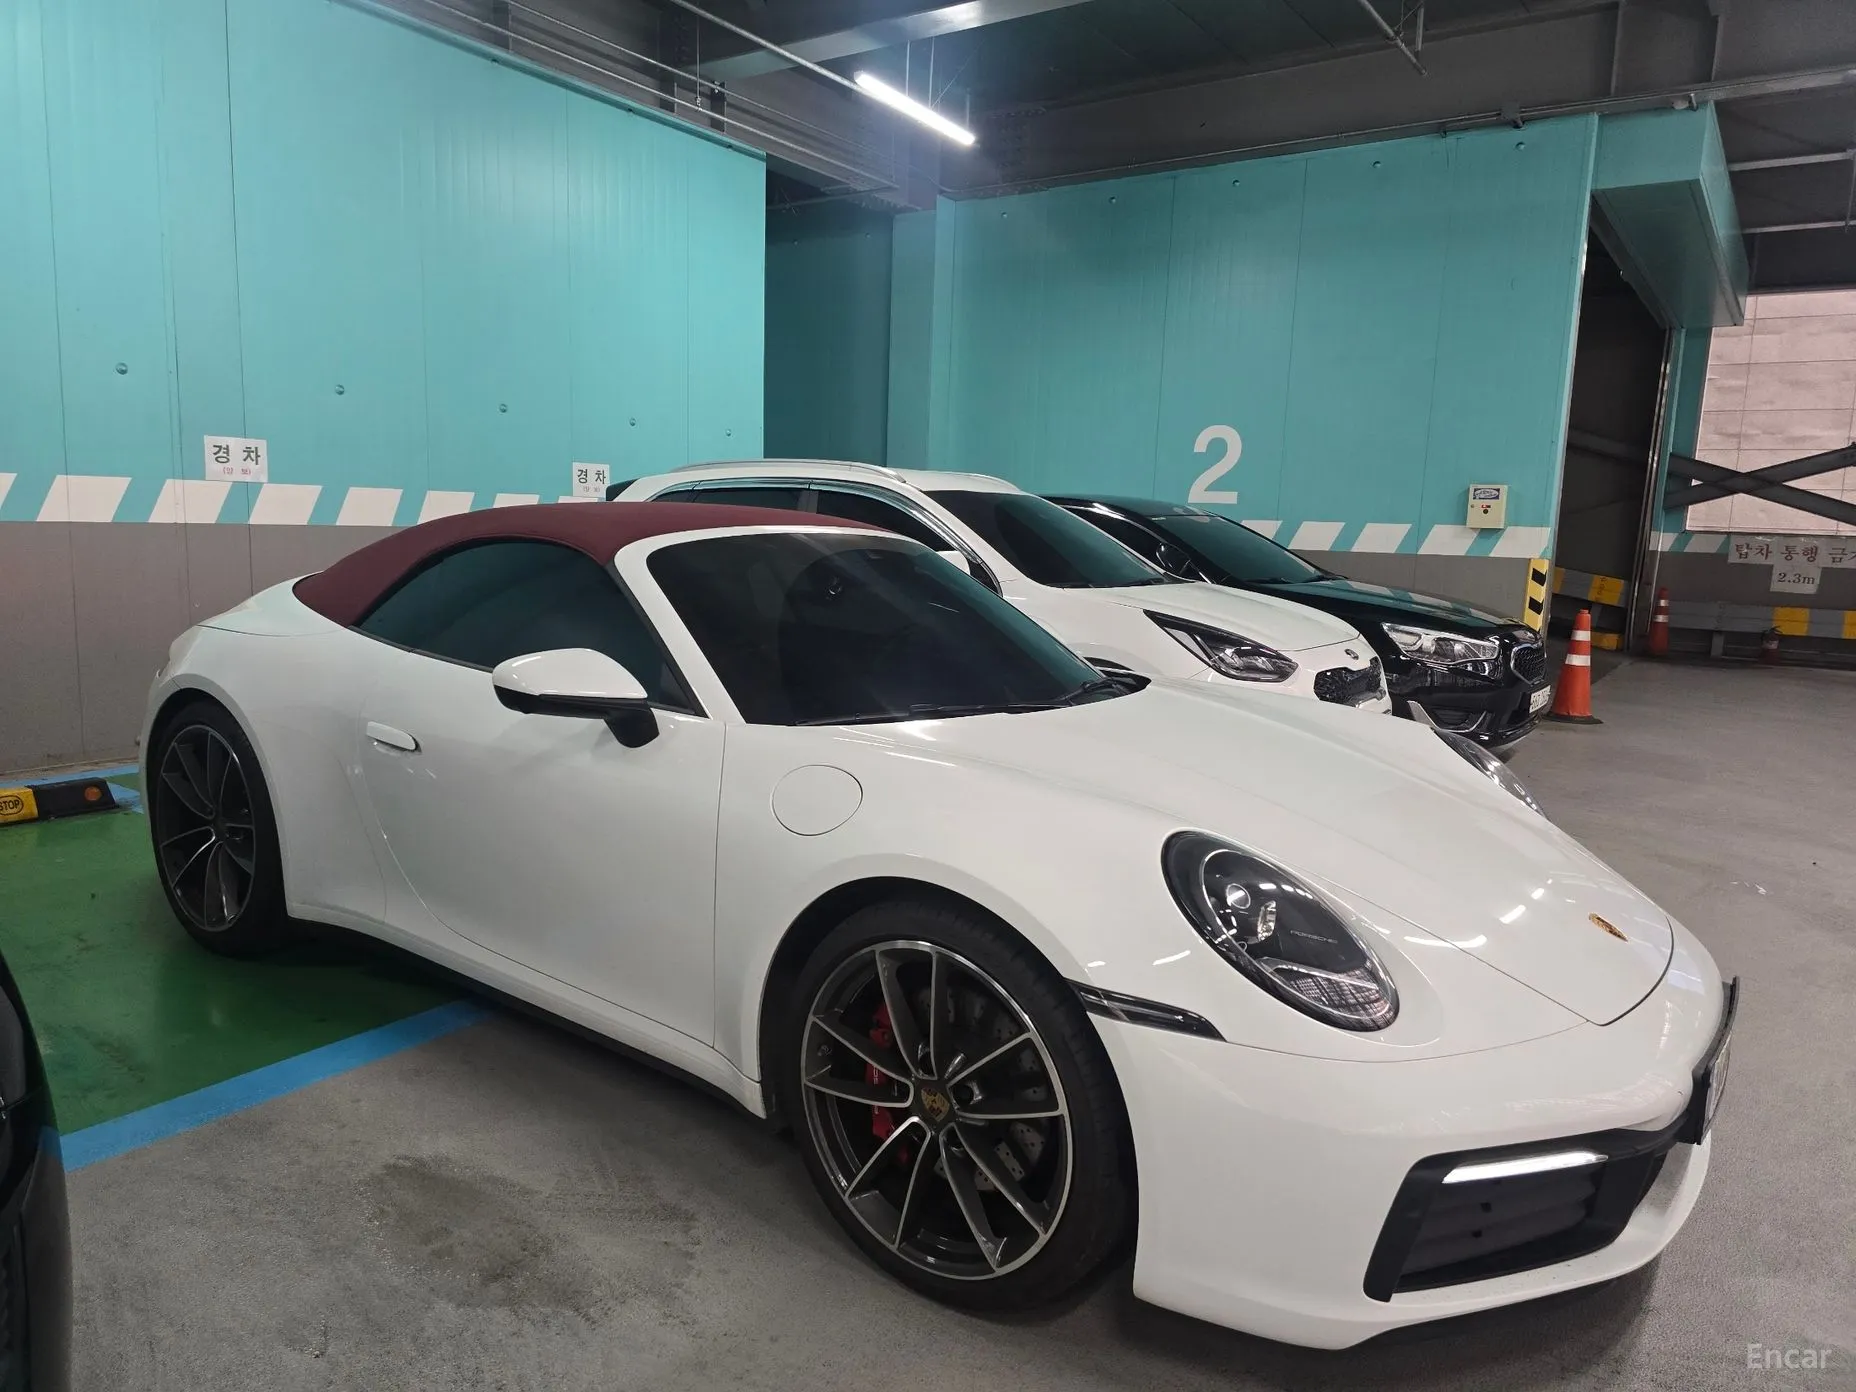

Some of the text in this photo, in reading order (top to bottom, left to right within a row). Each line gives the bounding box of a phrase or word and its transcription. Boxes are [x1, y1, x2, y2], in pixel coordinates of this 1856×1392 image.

[1187, 424, 1242, 505] 2
[1780, 545, 1819, 563] 통행
[1777, 572, 1816, 585] 2.3m
